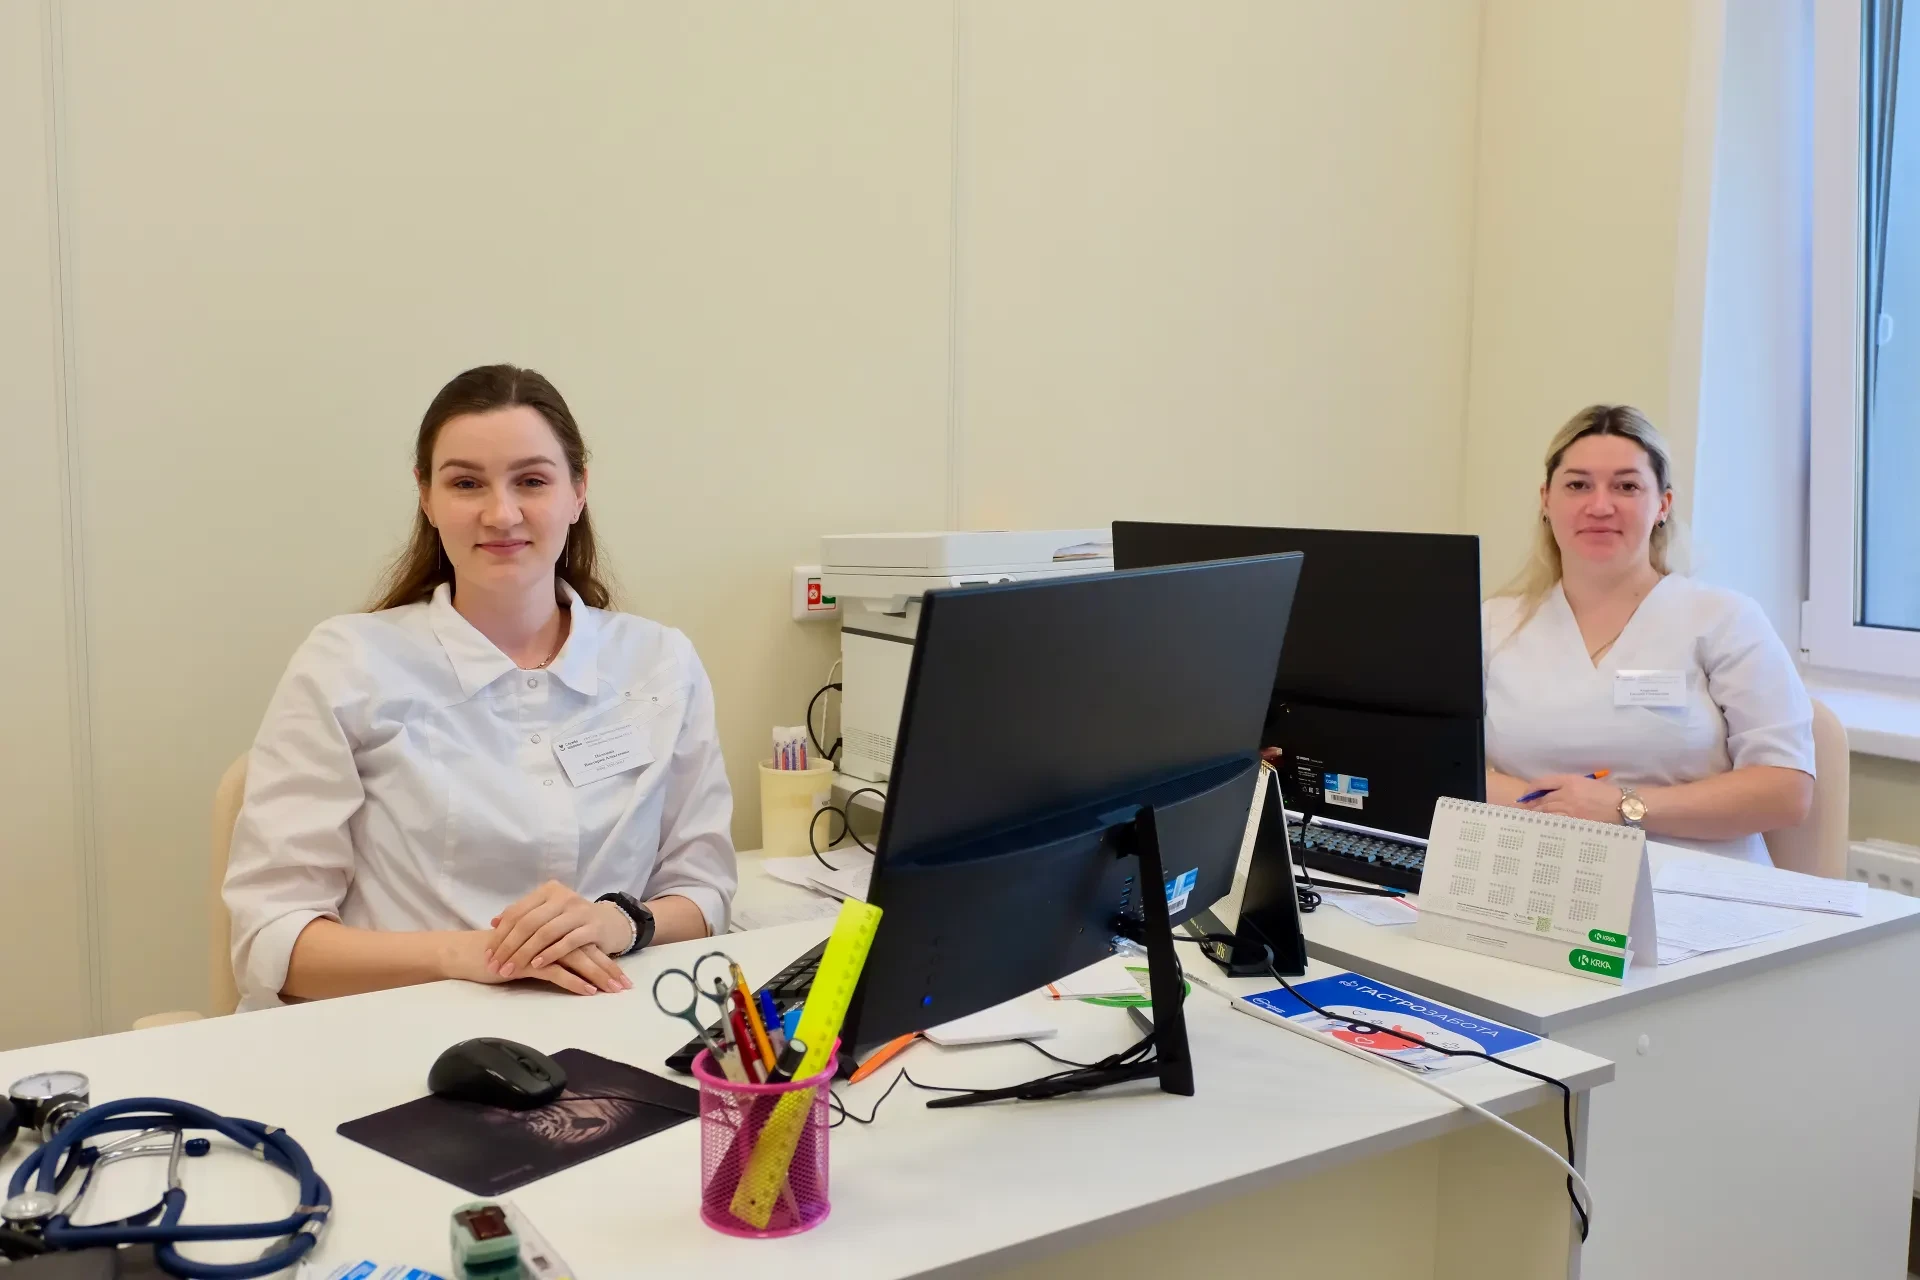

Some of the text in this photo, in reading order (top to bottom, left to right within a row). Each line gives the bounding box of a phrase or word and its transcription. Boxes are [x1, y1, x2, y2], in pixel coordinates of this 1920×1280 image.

[1602, 935, 1617, 944] KRKA
[1590, 957, 1612, 971] KRKA
[1356, 985, 1499, 1038] ГАСТРОЗАБОТА
